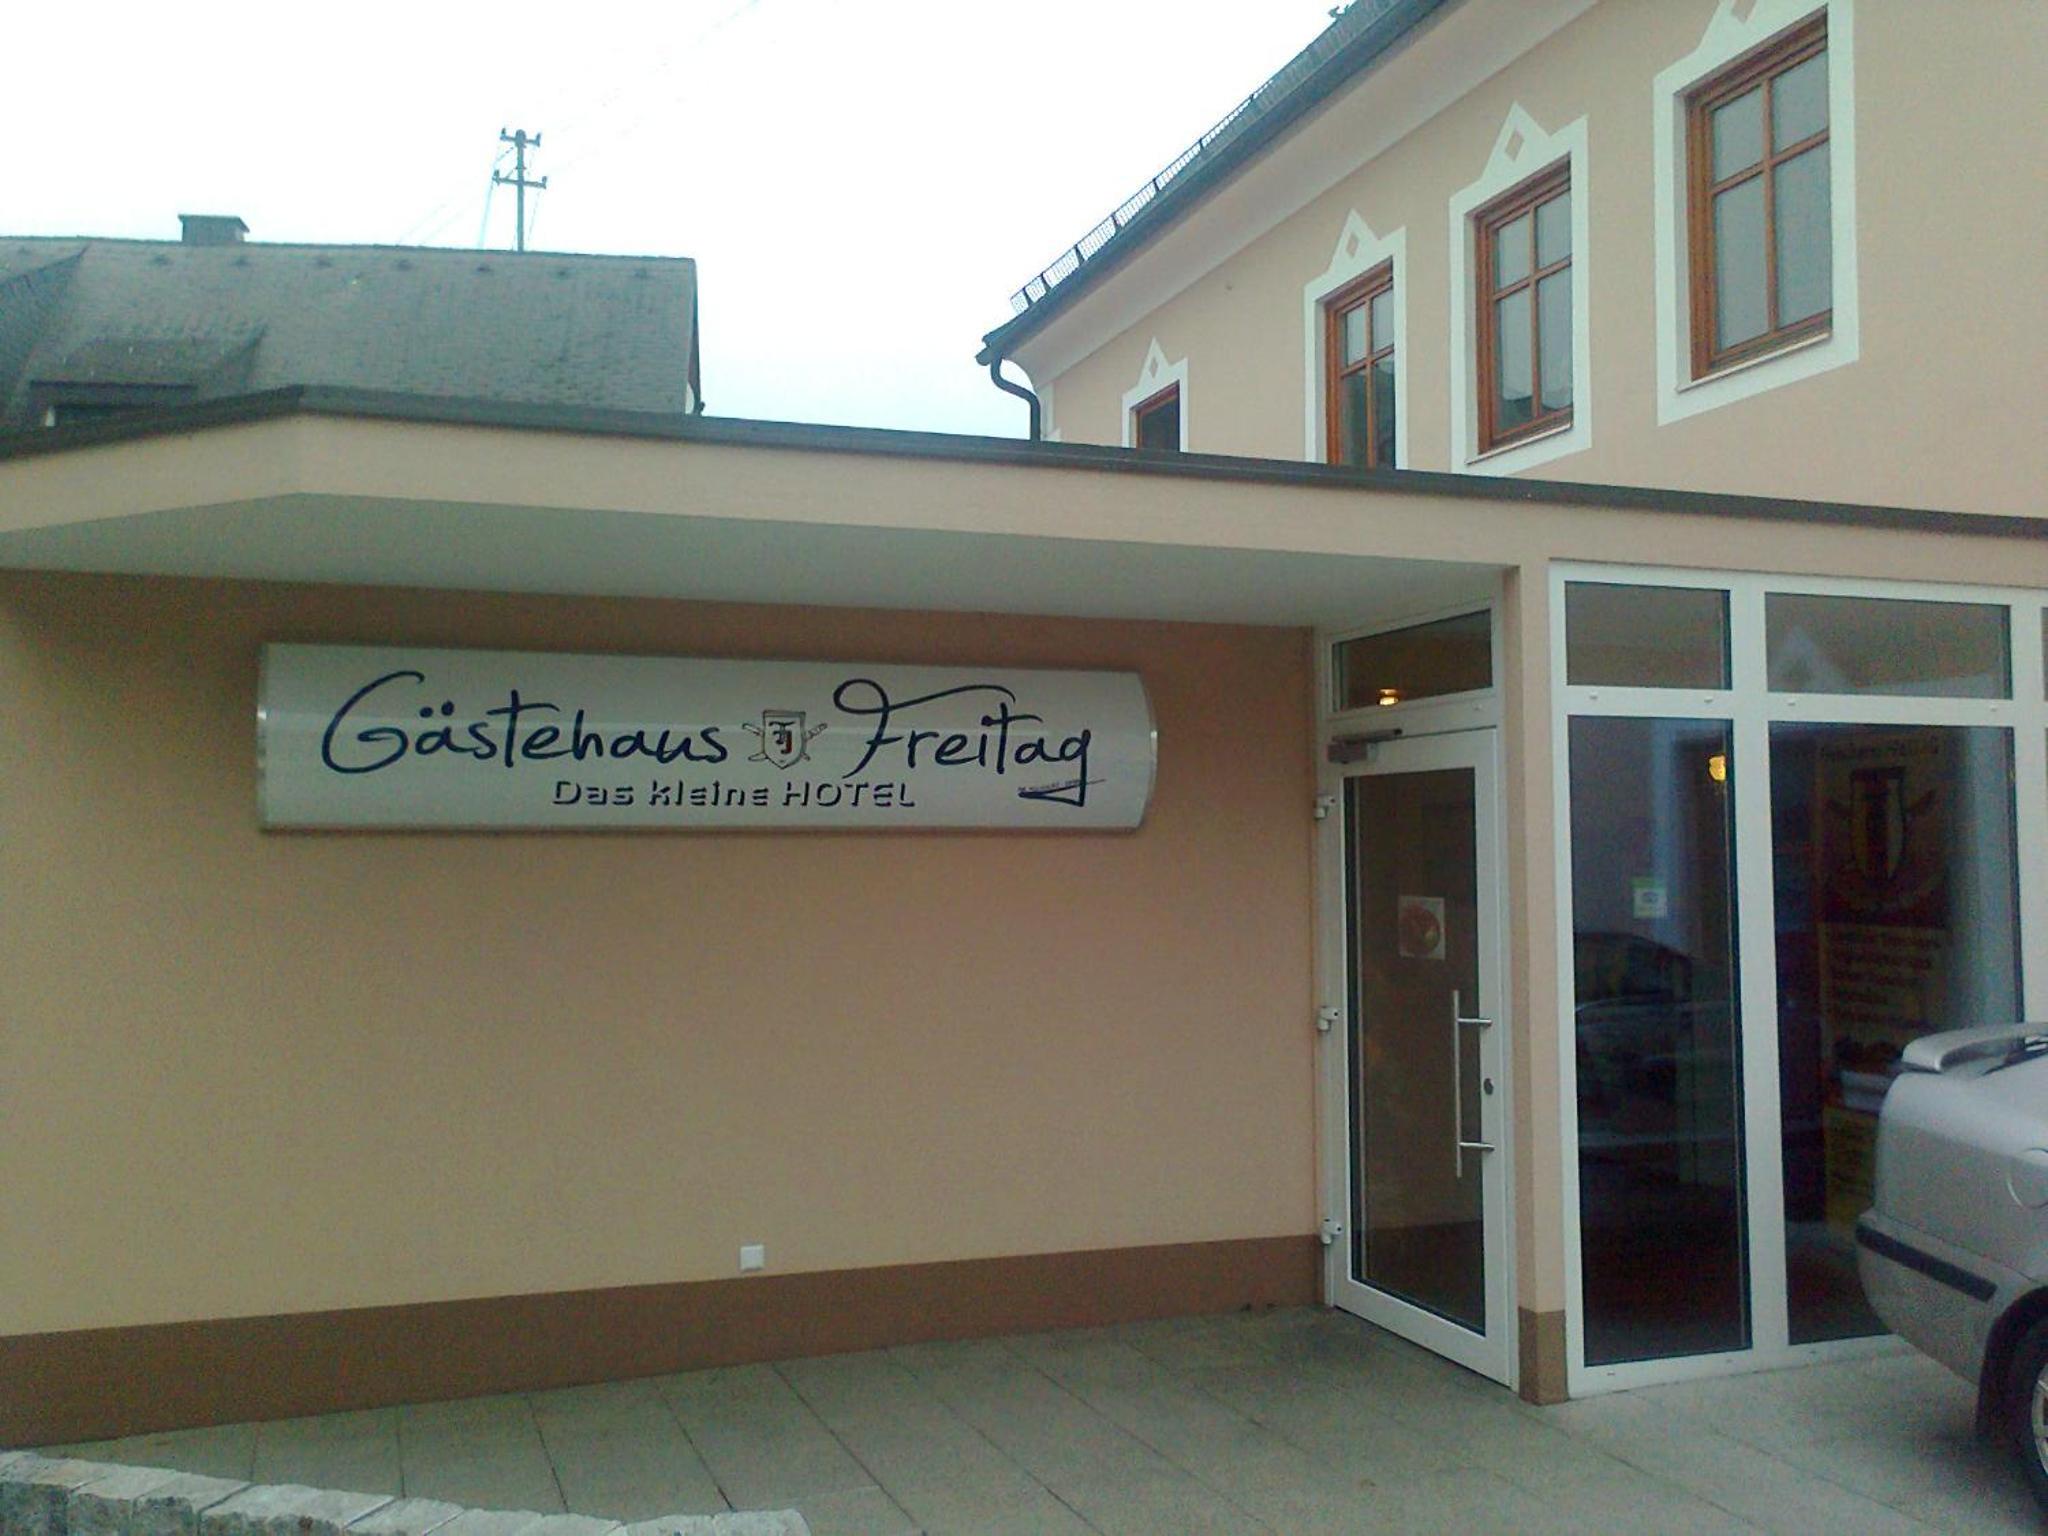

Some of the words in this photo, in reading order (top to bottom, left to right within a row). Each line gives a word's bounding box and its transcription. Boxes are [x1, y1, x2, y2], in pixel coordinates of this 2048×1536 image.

[321, 670, 729, 774] Gästehaus
[833, 678, 1106, 808] Freitag
[552, 780, 635, 806] Das
[648, 780, 768, 807] kleine
[782, 781, 916, 808] HOTEL
